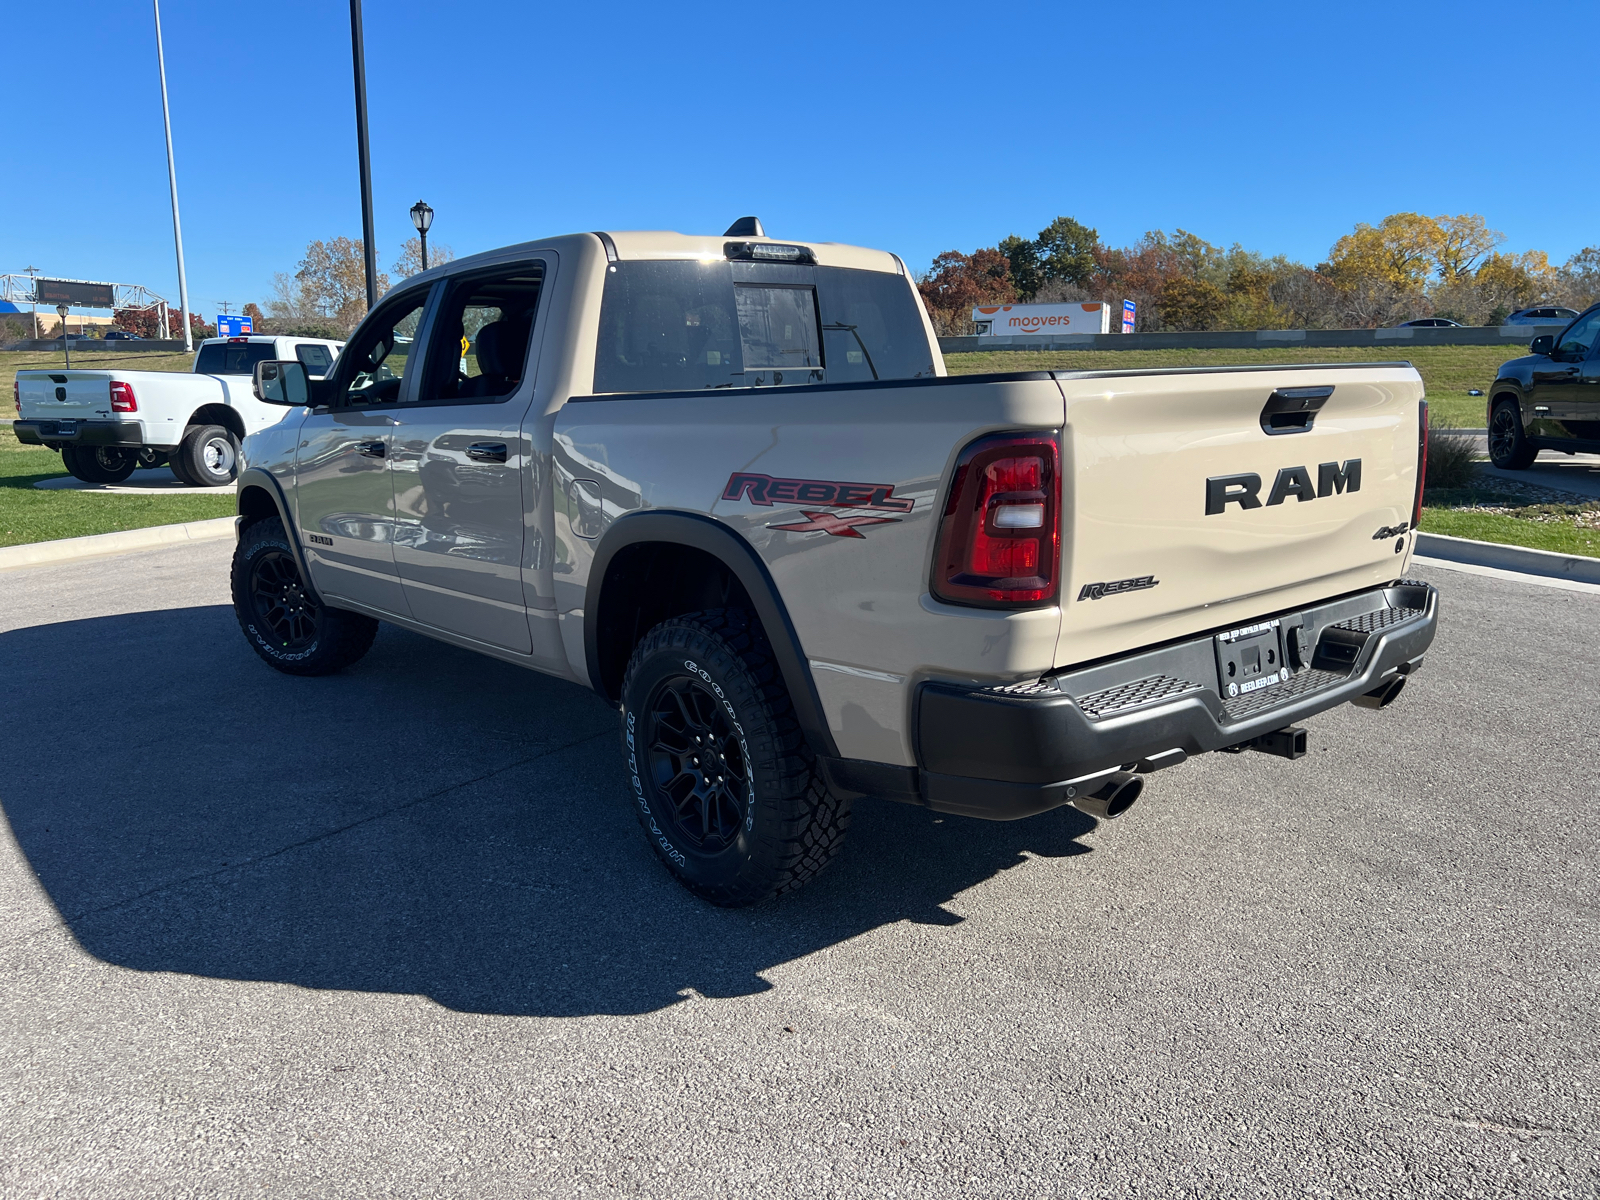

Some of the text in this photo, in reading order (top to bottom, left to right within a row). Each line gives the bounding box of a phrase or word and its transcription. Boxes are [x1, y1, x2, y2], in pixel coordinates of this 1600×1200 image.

[1009, 316, 1071, 327] moovers
[721, 472, 915, 513] REBEL
[1204, 458, 1362, 516] RAM
[309, 534, 333, 546] RAM
[1077, 575, 1160, 602] REBEL
[1240, 673, 1280, 694] REEDJEEP.COM
[684, 660, 754, 831] GOODYEAR
[625, 712, 686, 867] WRANGLER
